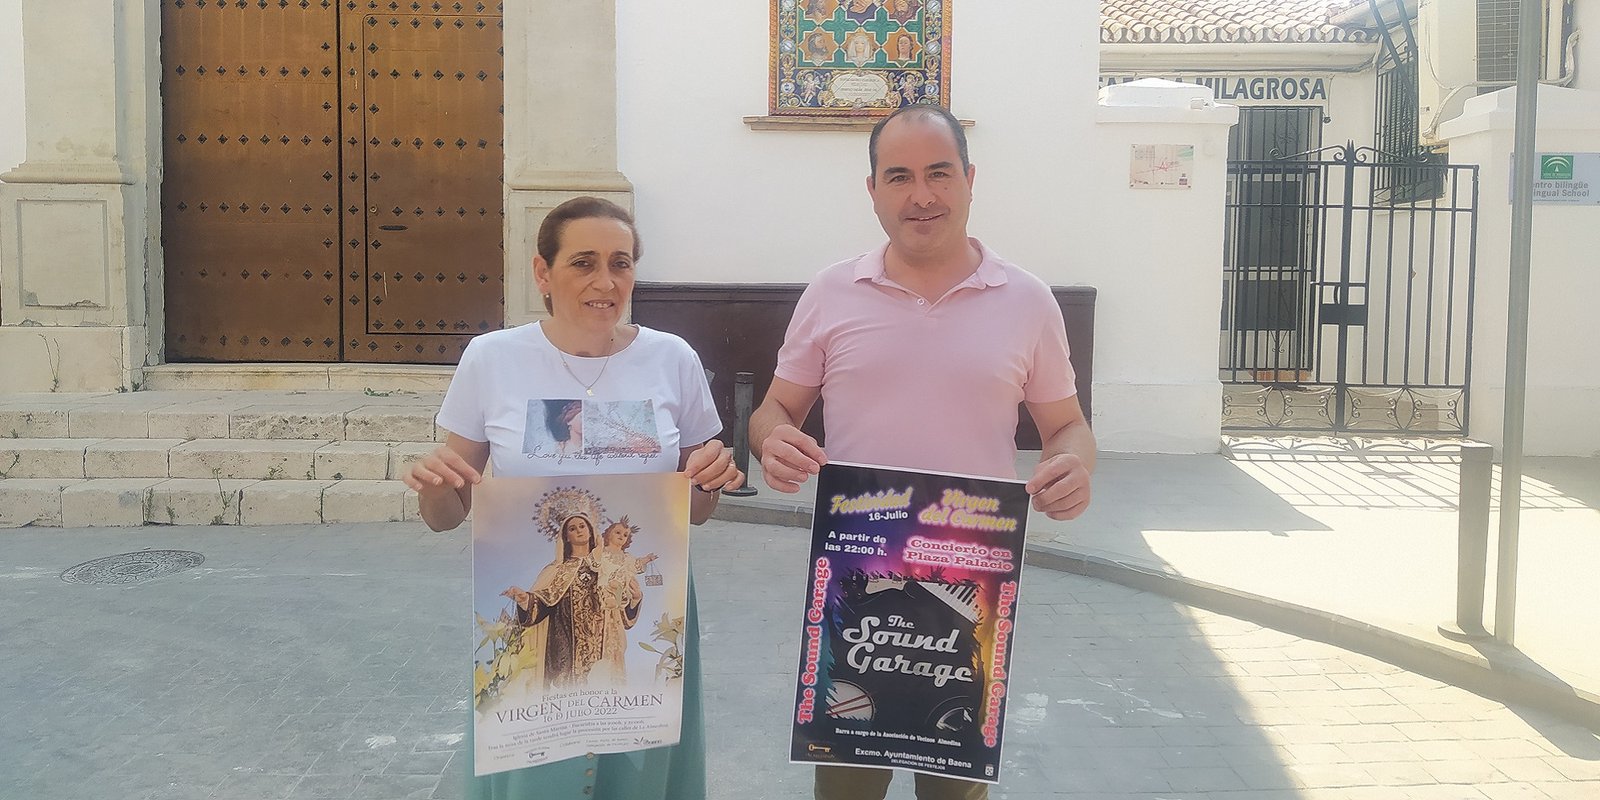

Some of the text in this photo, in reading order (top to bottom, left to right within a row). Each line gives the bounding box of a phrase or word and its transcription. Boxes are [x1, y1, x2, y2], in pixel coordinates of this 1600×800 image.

[1533, 189, 1590, 198] ingual School
[1555, 180, 1589, 190] bilingüe
[829, 486, 913, 514] Festividad
[941, 488, 1000, 513] Virgen
[868, 510, 908, 521] 16-Julio
[918, 503, 1017, 532] del Carmen
[828, 530, 887, 544] A partir de
[824, 542, 887, 556] las 22:00 h.
[910, 539, 1012, 558] Concierto en
[906, 551, 1013, 571] Plaza Palacio
[887, 614, 915, 629] The
[798, 557, 830, 724] The Sound Garage
[842, 616, 960, 654] Sound
[846, 642, 974, 688] Garage
[982, 581, 1017, 747] The Sound Garage
[542, 693, 566, 702] Fiestas
[580, 688, 602, 696] honor
[496, 693, 663, 724] VIRGEN DEL CARMEN
[594, 708, 618, 716] 2022
[855, 747, 972, 768] Excmo. Ayuntamiento de Baena
